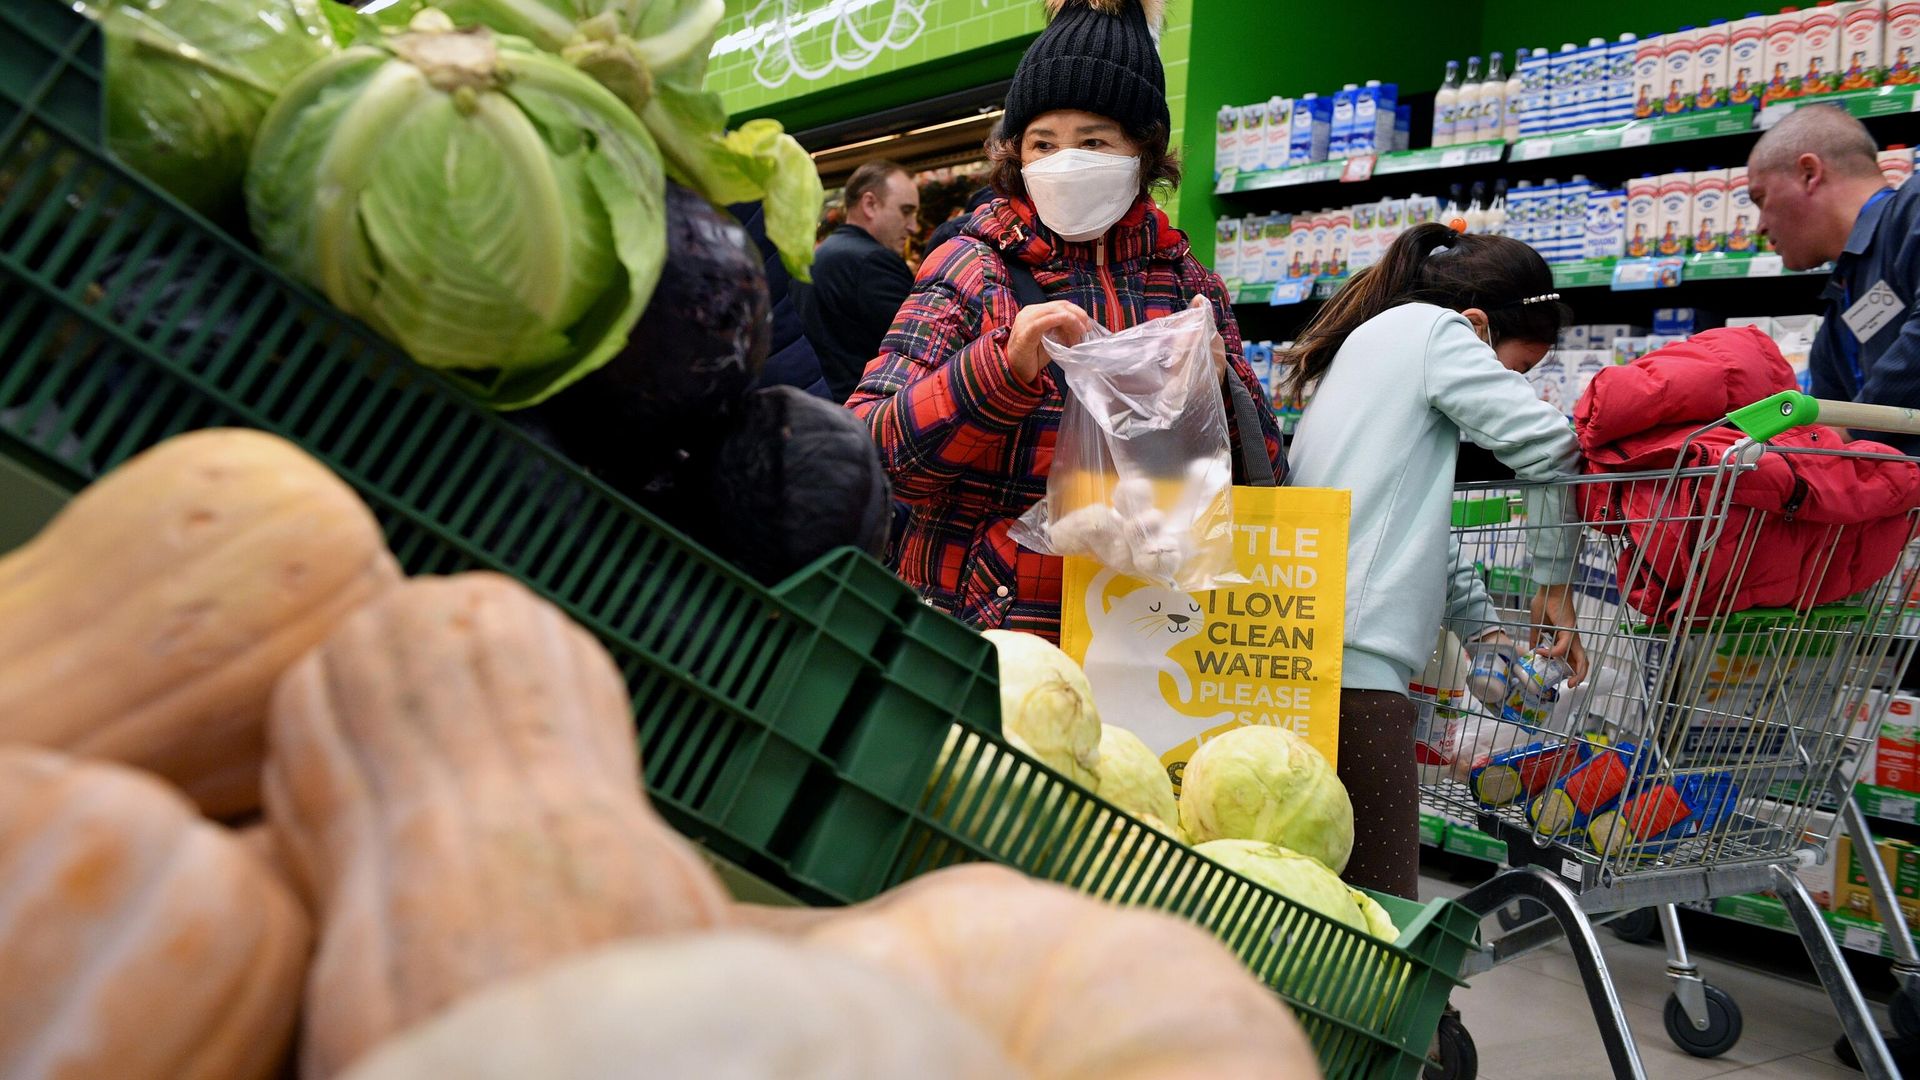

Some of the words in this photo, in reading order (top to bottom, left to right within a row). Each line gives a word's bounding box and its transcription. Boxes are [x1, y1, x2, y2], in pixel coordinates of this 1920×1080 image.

[1250, 563, 1317, 589] AND
[1208, 589, 1216, 614] I
[1227, 592, 1316, 619] LOVE
[1207, 621, 1314, 650] CLEAN
[1194, 650, 1318, 681] WATER.
[1200, 681, 1311, 710] PLEASE
[1237, 711, 1310, 737] SAVE
